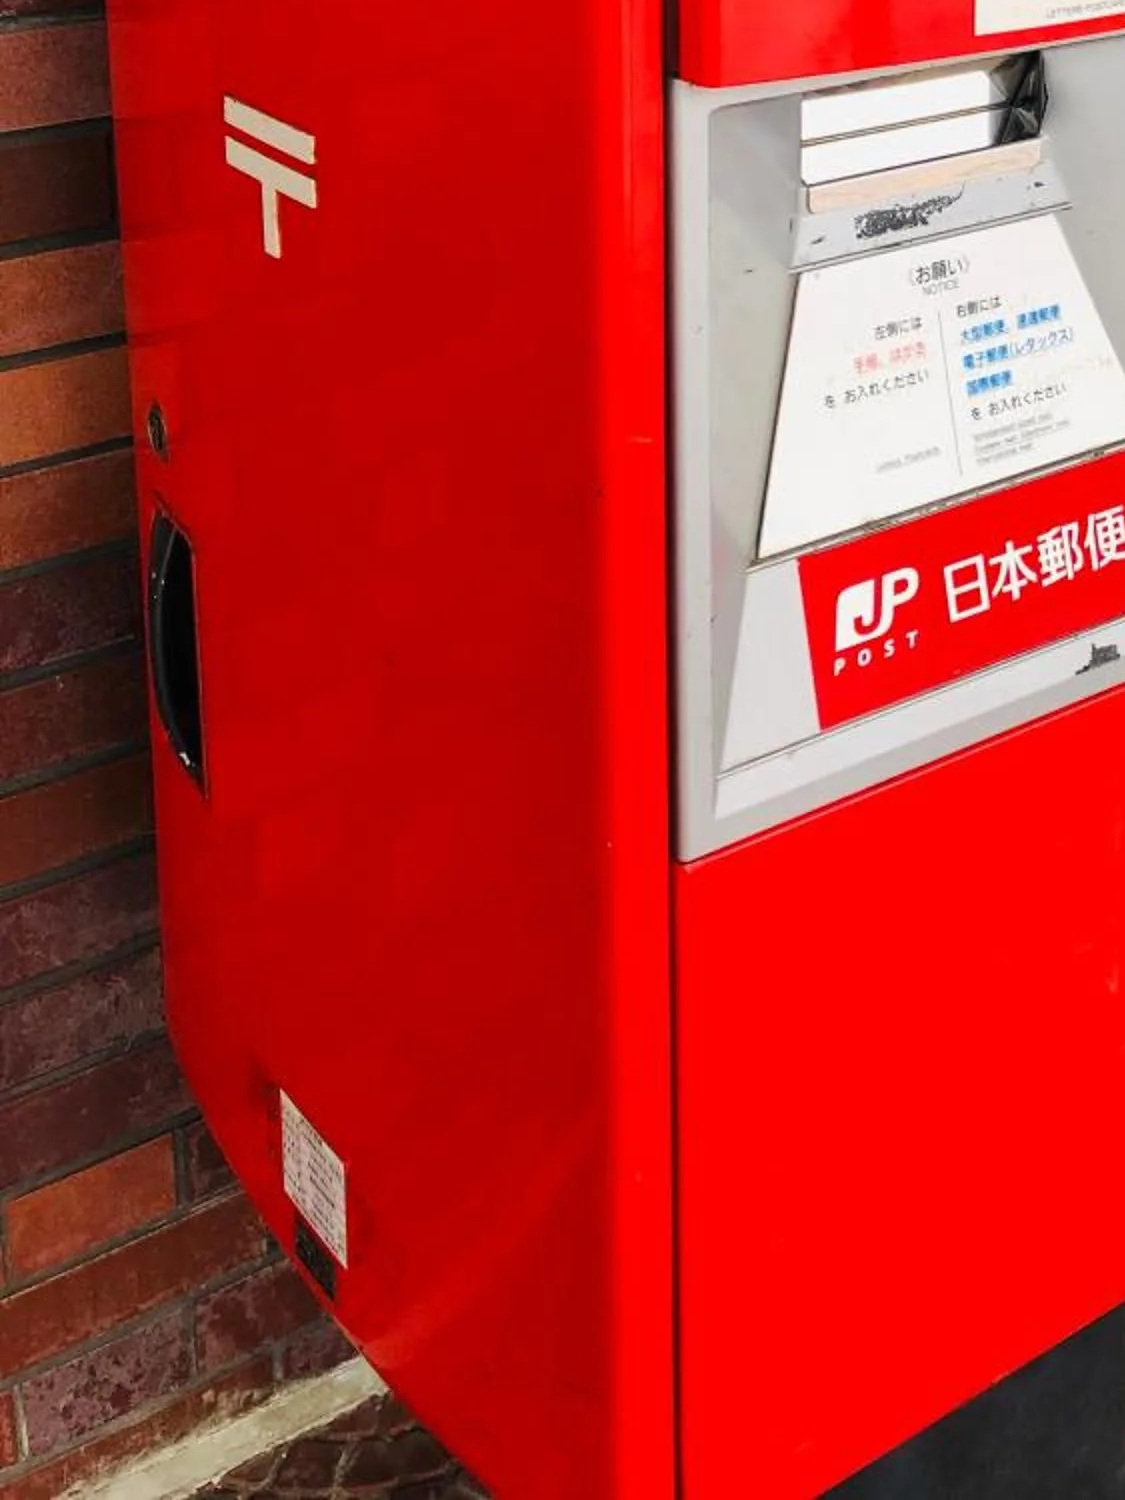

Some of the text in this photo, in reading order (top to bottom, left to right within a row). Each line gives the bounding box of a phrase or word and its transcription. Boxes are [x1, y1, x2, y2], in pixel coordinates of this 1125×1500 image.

[922, 279, 960, 296] NOTICE
[874, 316, 923, 341] 左側には
[844, 369, 929, 404] お入れください
[988, 382, 1067, 416] お入れください
[833, 631, 919, 677] POST
